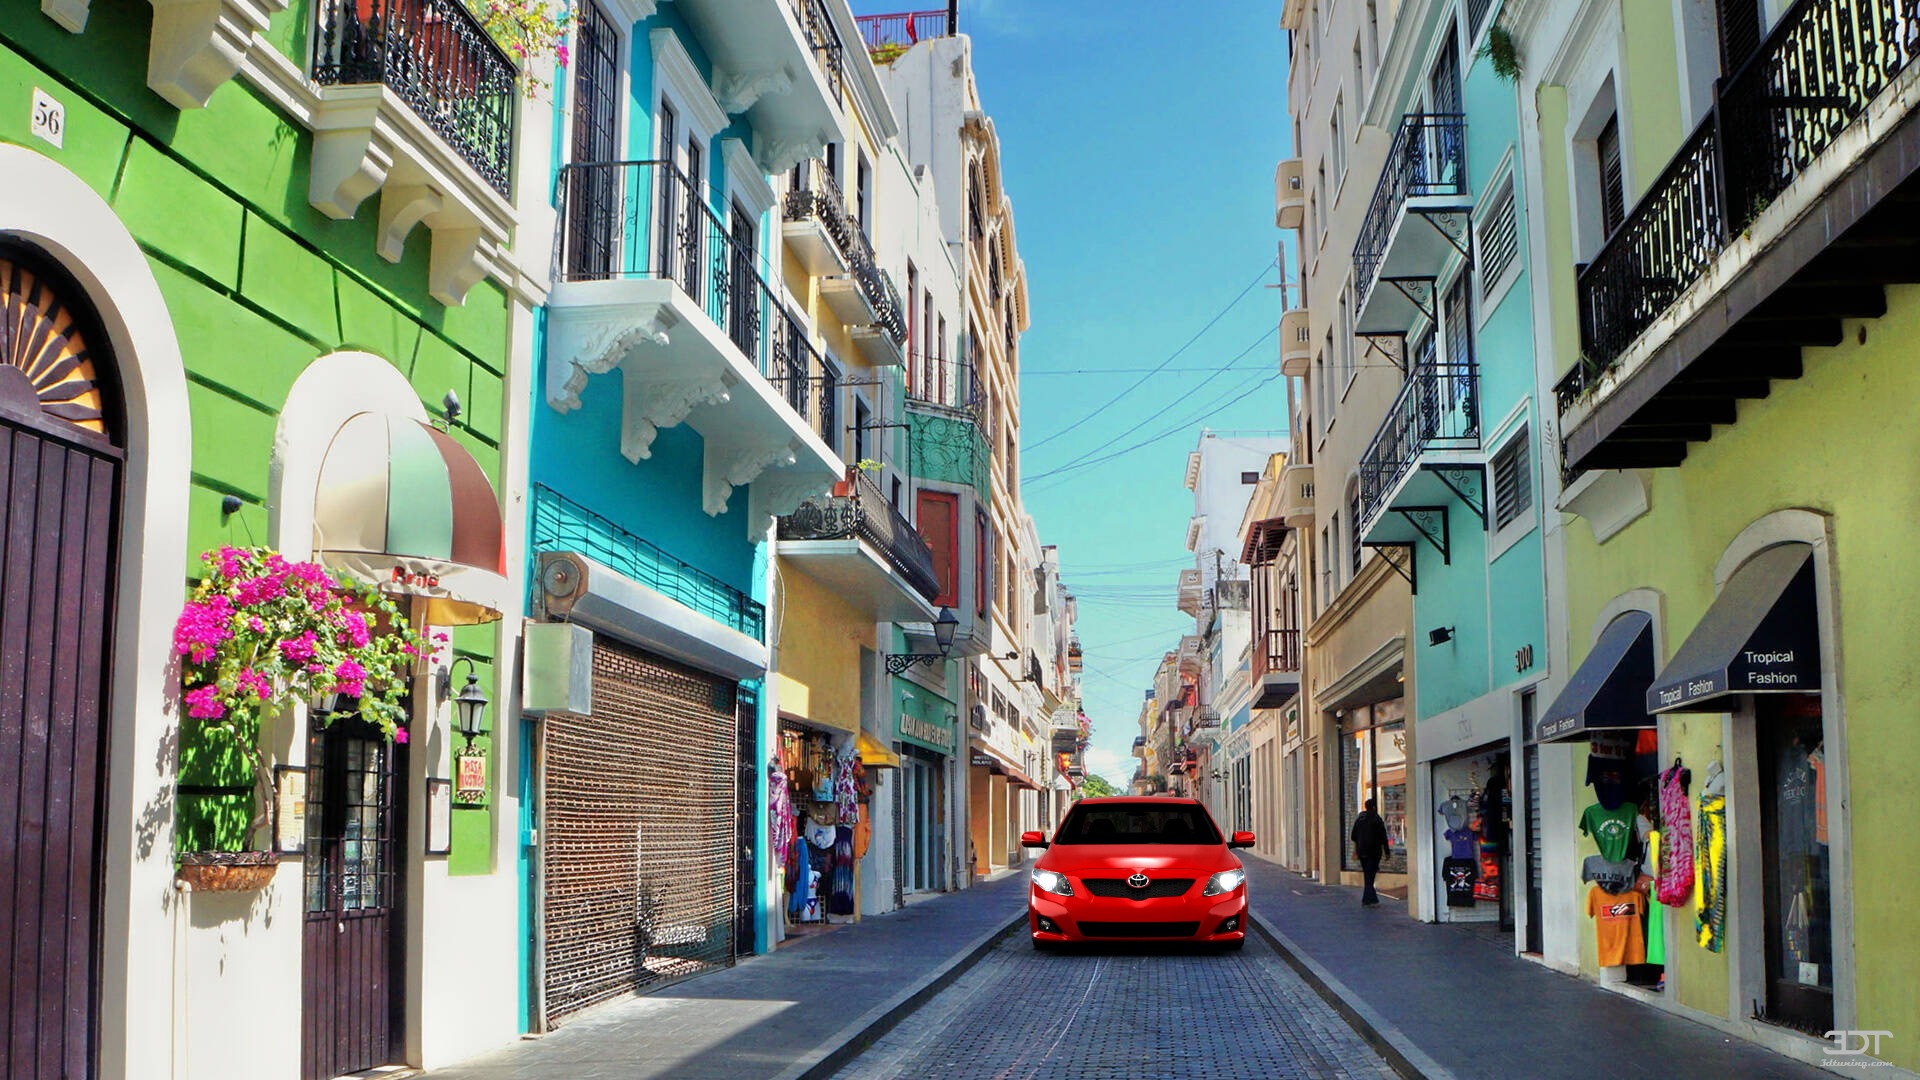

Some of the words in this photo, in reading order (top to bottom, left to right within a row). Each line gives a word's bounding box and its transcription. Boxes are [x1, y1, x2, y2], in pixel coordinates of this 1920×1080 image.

[35, 101, 59, 135] 56
[1515, 644, 1533, 673] 300
[1745, 651, 1794, 666] Tropical
[1748, 672, 1798, 684] Fashion
[1659, 686, 1683, 706] Tropical
[1688, 679, 1714, 697] Fashion
[1542, 722, 1557, 737] Tropical
[1559, 718, 1575, 732] Fashion
